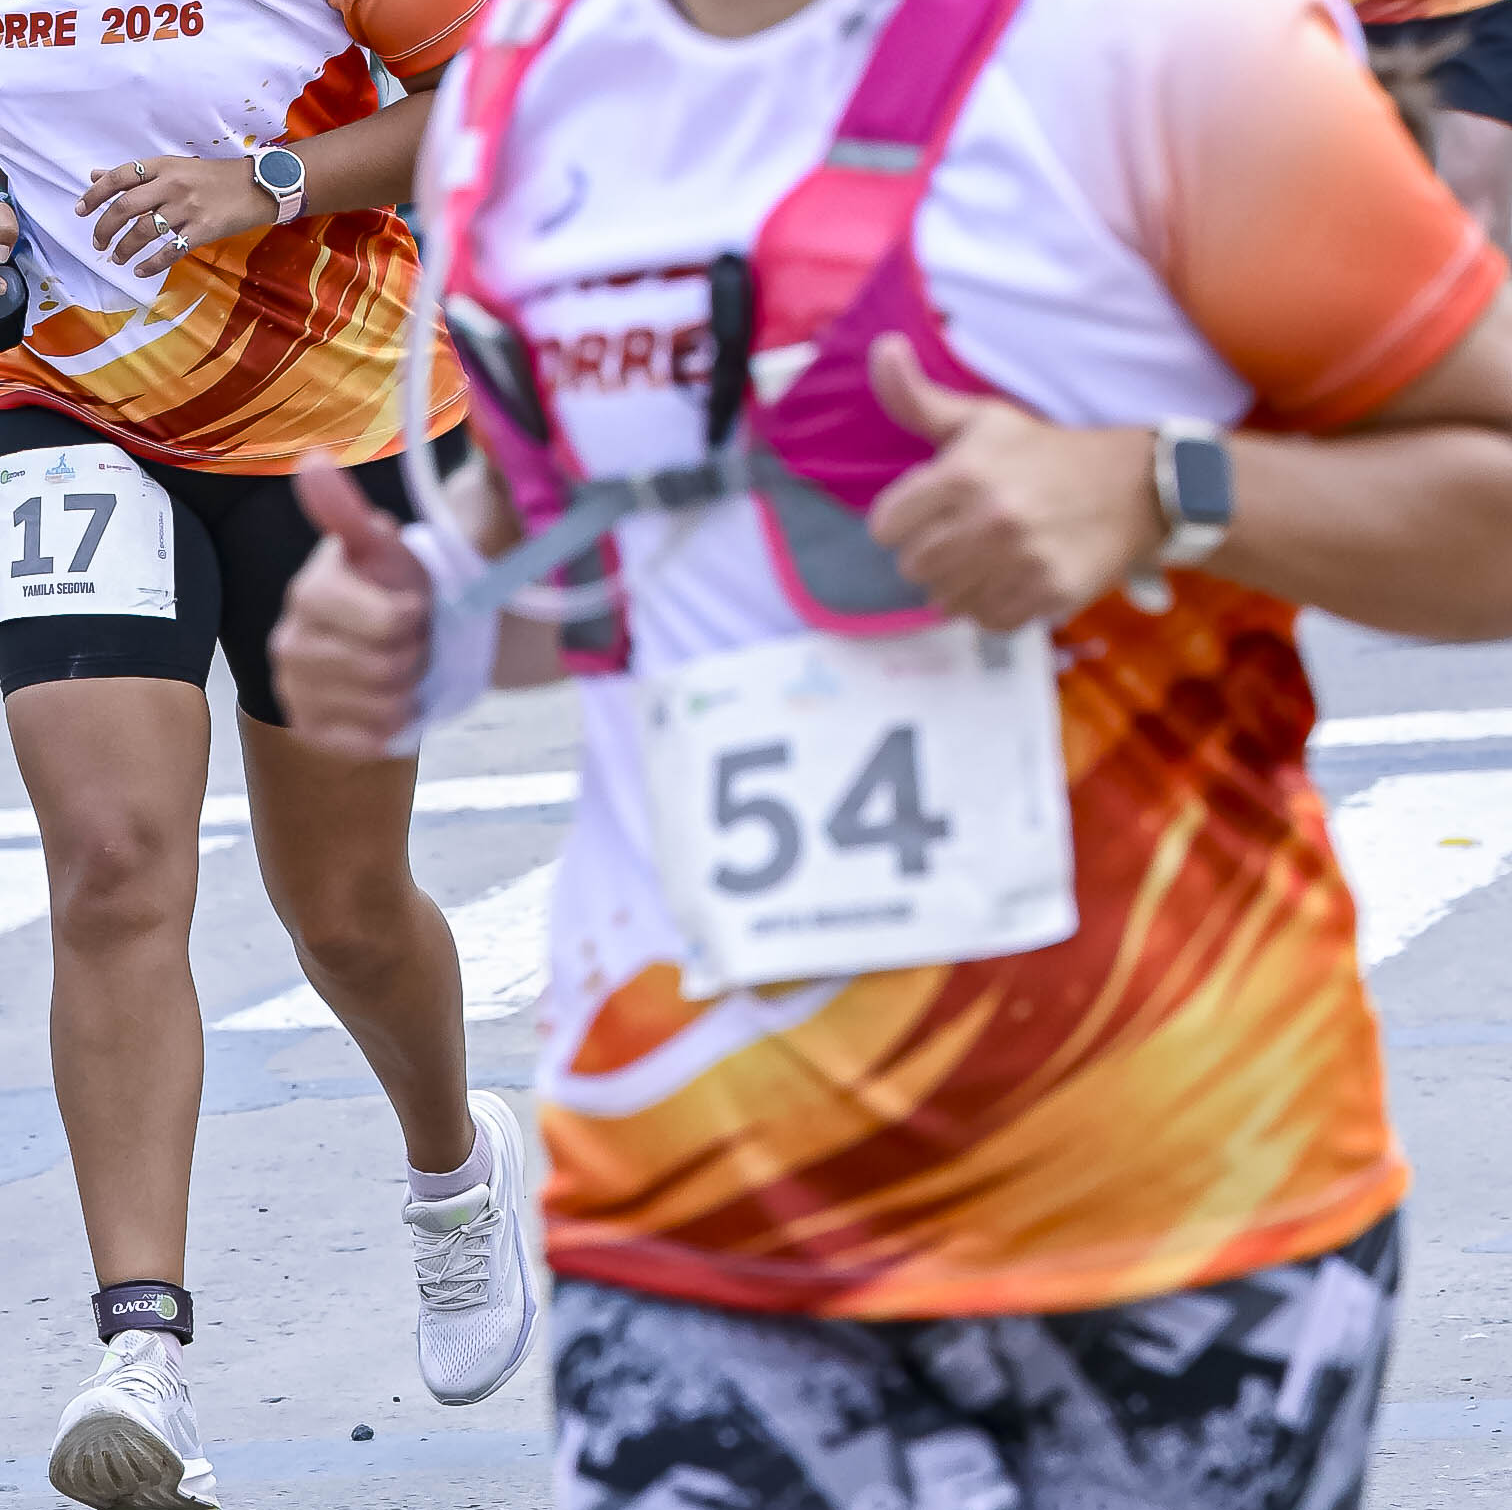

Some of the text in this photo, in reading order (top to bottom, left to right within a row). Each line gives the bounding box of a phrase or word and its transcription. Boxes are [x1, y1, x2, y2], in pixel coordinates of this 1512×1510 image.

[100, 0, 204, 45] 2026
[10, 493, 118, 578] 17
[22, 581, 96, 597] YAMILA SEGOVIA
[712, 724, 951, 896] 54
